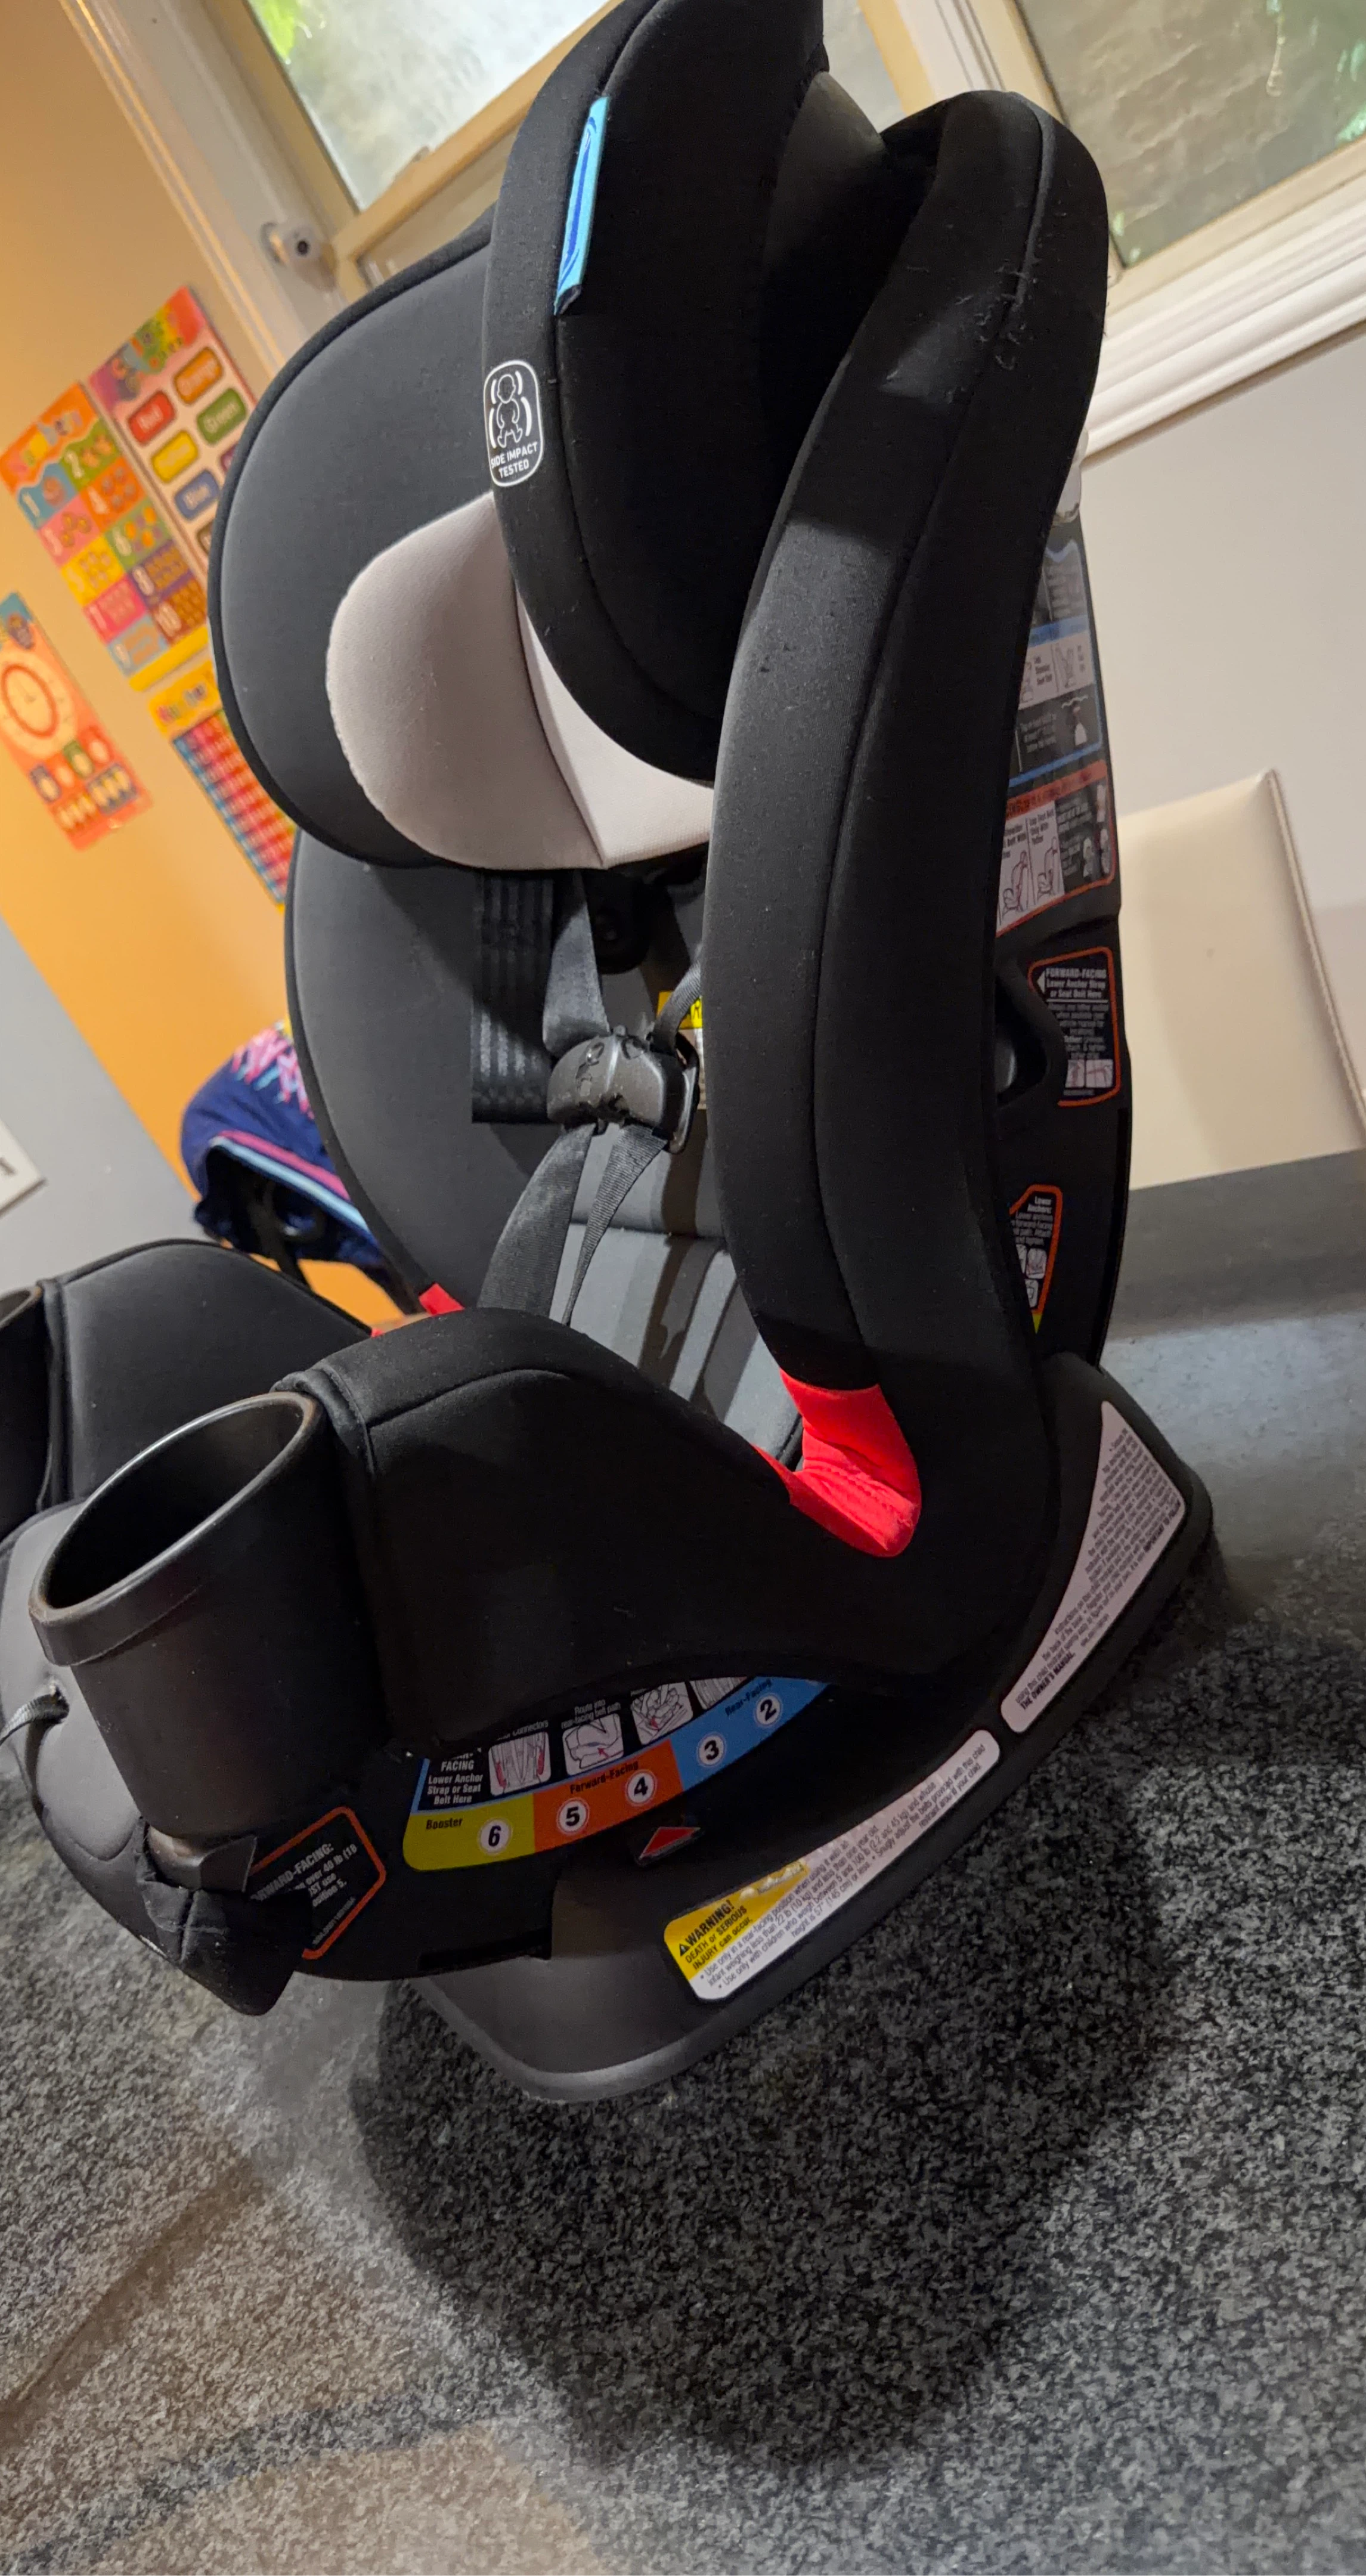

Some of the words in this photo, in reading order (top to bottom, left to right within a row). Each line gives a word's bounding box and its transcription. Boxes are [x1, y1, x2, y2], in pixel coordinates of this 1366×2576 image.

[491, 453, 505, 468] SIDE
[507, 441, 538, 460] IMPACT
[498, 459, 529, 478] TESTED
[1046, 967, 1107, 979] FORWARD-FACING
[724, 1679, 772, 1717] Rear-Facing
[1020, 1698, 1032, 1710] THE
[760, 1699, 776, 1721] 2
[704, 1740, 720, 1761] 3
[441, 1760, 474, 1771] FACING
[428, 1775, 453, 1784] Lower
[454, 1773, 483, 1783] Anchor
[570, 1761, 639, 1794] Forward-Facing
[633, 1776, 648, 1798] 4
[427, 1786, 450, 1795] Strap
[463, 1784, 481, 1792] Seat
[433, 1795, 450, 1805] Belt
[453, 1795, 472, 1803] Here
[426, 1818, 463, 1829] Booster
[565, 1807, 581, 1826] 5
[488, 1825, 501, 1847] 6
[251, 1844, 333, 1900] RWARD-FACING:
[305, 1870, 322, 1885] over
[322, 1873, 336, 1886] use
[312, 1885, 337, 1907] osition
[686, 1900, 734, 1945] WARNING!
[704, 1963, 718, 1976] Use
[717, 1952, 731, 1965] only
[742, 1914, 773, 1943] rear-facing
[772, 1894, 794, 1917] position
[795, 1880, 810, 1894] when
[685, 1941, 708, 1963] DEATH
[709, 1934, 716, 1943] or
[716, 1906, 747, 1935] SERIOUS
[693, 1945, 718, 1970] INJURY
[719, 1935, 732, 1947] can
[708, 1969, 725, 1986] infant
[726, 1946, 752, 1971] weighing
[762, 1924, 776, 1937] than
[775, 1914, 785, 1926] 22
[723, 1973, 736, 1985] Use
[749, 1950, 762, 1963] with
[761, 1930, 785, 1952] children
[784, 1918, 797, 1931] who
